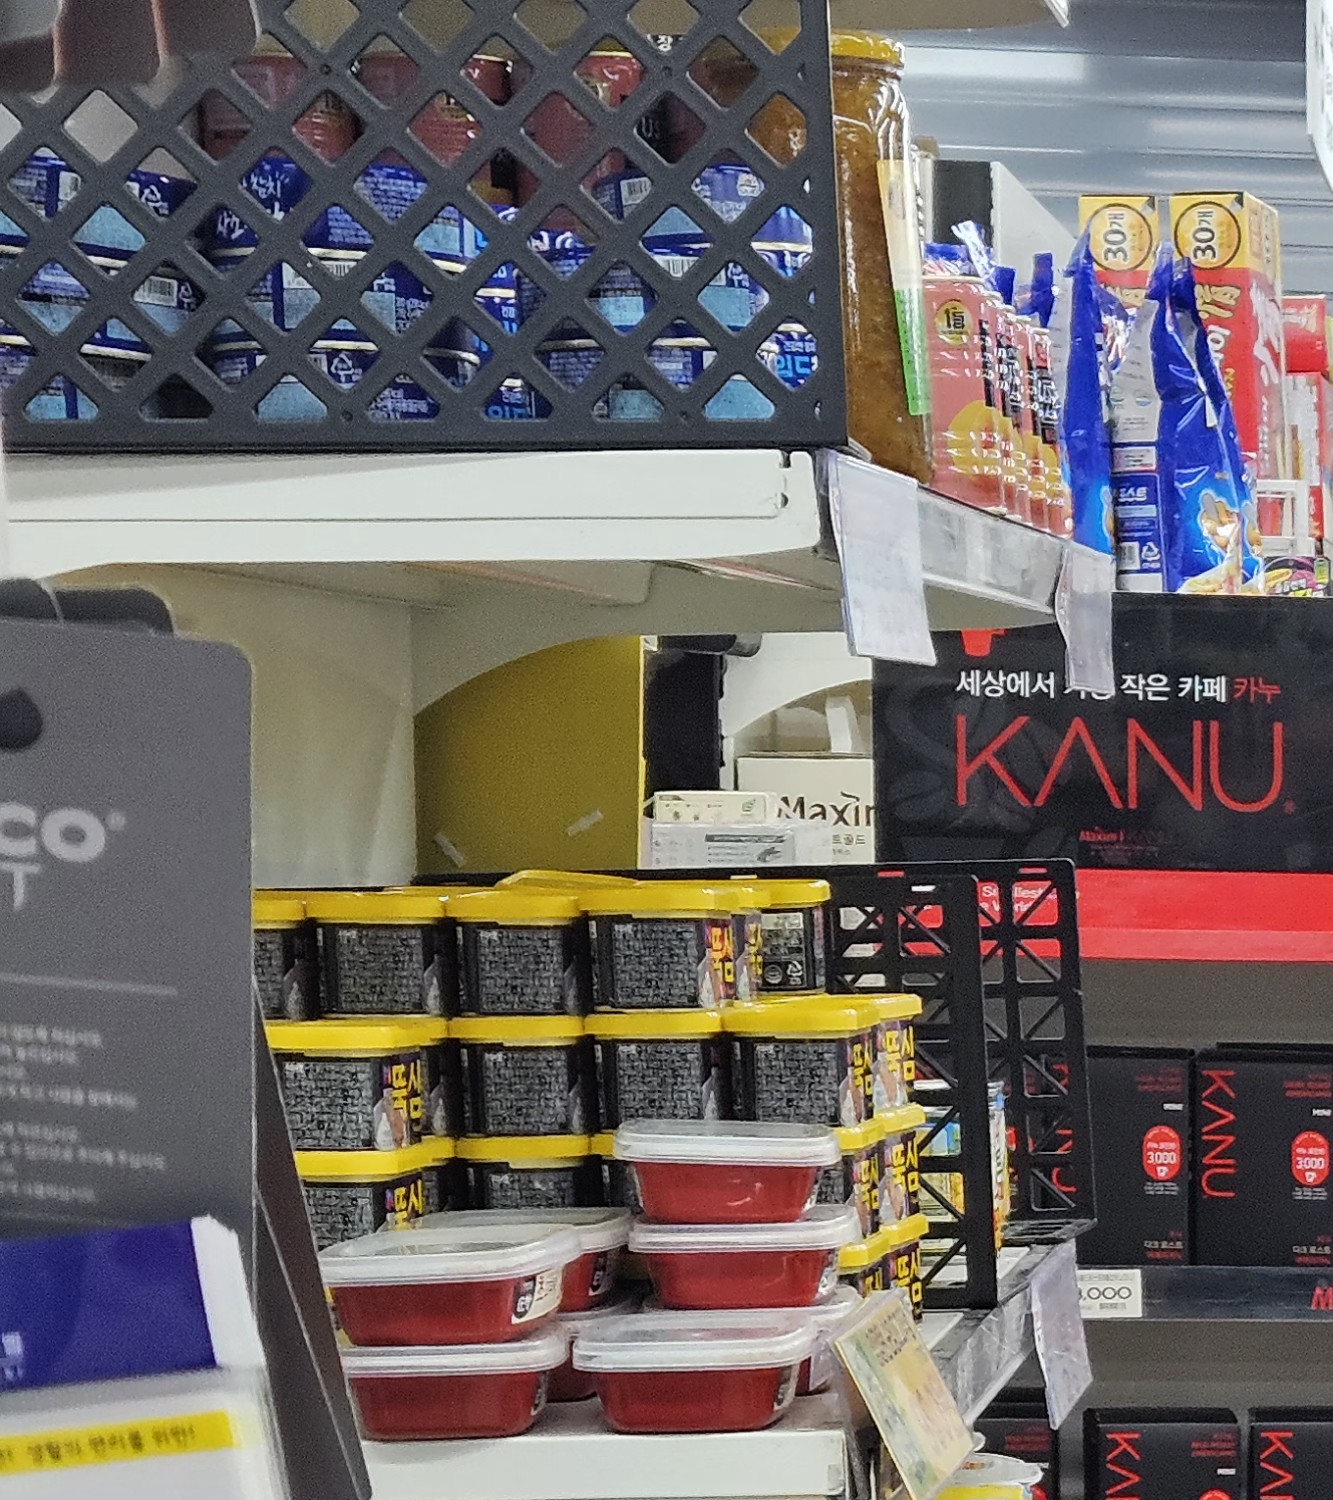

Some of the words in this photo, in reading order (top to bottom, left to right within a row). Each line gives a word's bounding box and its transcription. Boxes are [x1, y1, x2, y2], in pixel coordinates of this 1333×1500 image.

[1104, 211, 1126, 263] 30개
[1193, 208, 1215, 260] 30개
[956, 670, 1056, 699] 세상에서
[1120, 671, 1171, 698] 작은
[1178, 670, 1227, 701] 카페
[1232, 672, 1281, 703] 카누
[955, 713, 1284, 813] KANU
[885, 1024, 915, 1083] 뚝심
[891, 1131, 920, 1192] 뚝심
[1201, 1069, 1237, 1199] KANU
[1079, 1286, 1132, 1302] ,000
